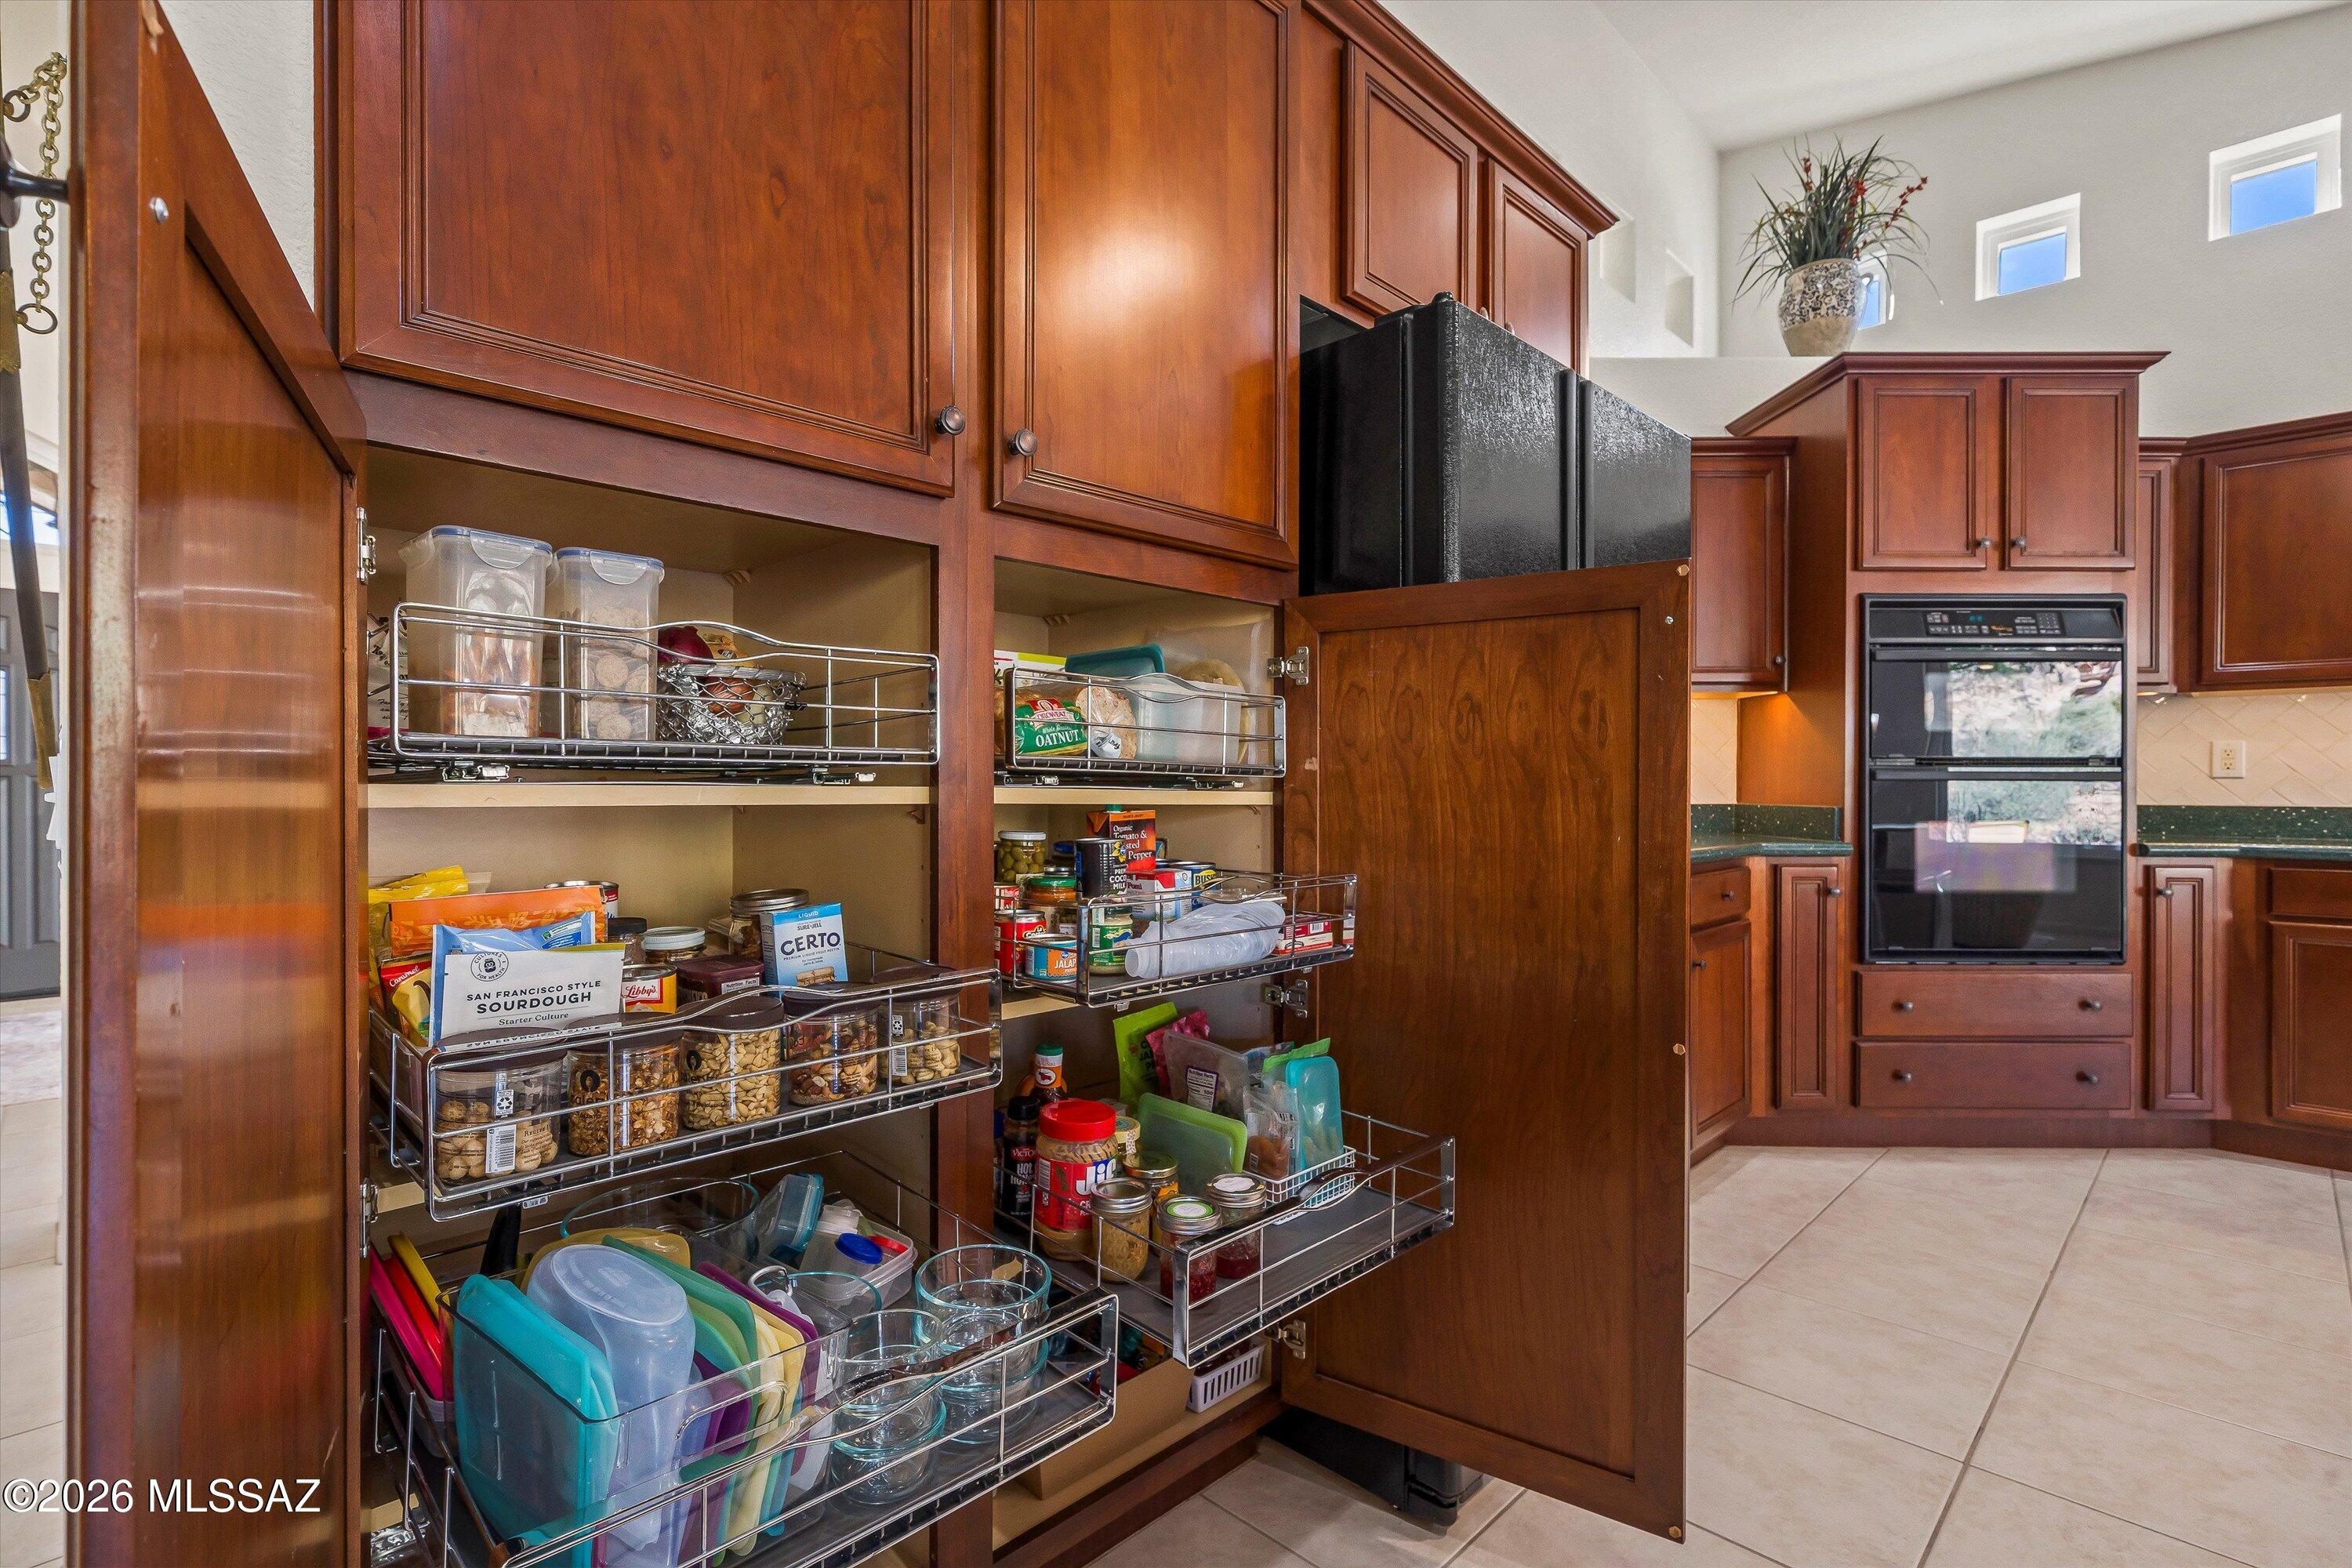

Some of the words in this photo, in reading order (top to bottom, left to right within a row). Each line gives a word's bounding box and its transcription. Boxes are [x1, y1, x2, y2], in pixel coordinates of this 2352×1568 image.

[1035, 729, 1080, 747] OATNUT
[1140, 829, 1148, 839] &
[1125, 839, 1140, 849] sted
[1128, 851, 1152, 861] Pepper
[780, 931, 841, 956] CERTO
[1054, 958, 1076, 969] JALAP
[389, 965, 420, 987] Caramel
[466, 992, 492, 1001] SAN
[495, 985, 564, 999] FRANCISCO
[567, 980, 601, 991] STYLE
[625, 984, 658, 999] Libby's
[477, 991, 592, 1014] SOURDOUGH
[499, 1016, 534, 1026] Starter
[535, 1012, 569, 1022] Culture
[1011, 1149, 1035, 1157] VICTO
[1076, 1158, 1116, 1196] Jif
